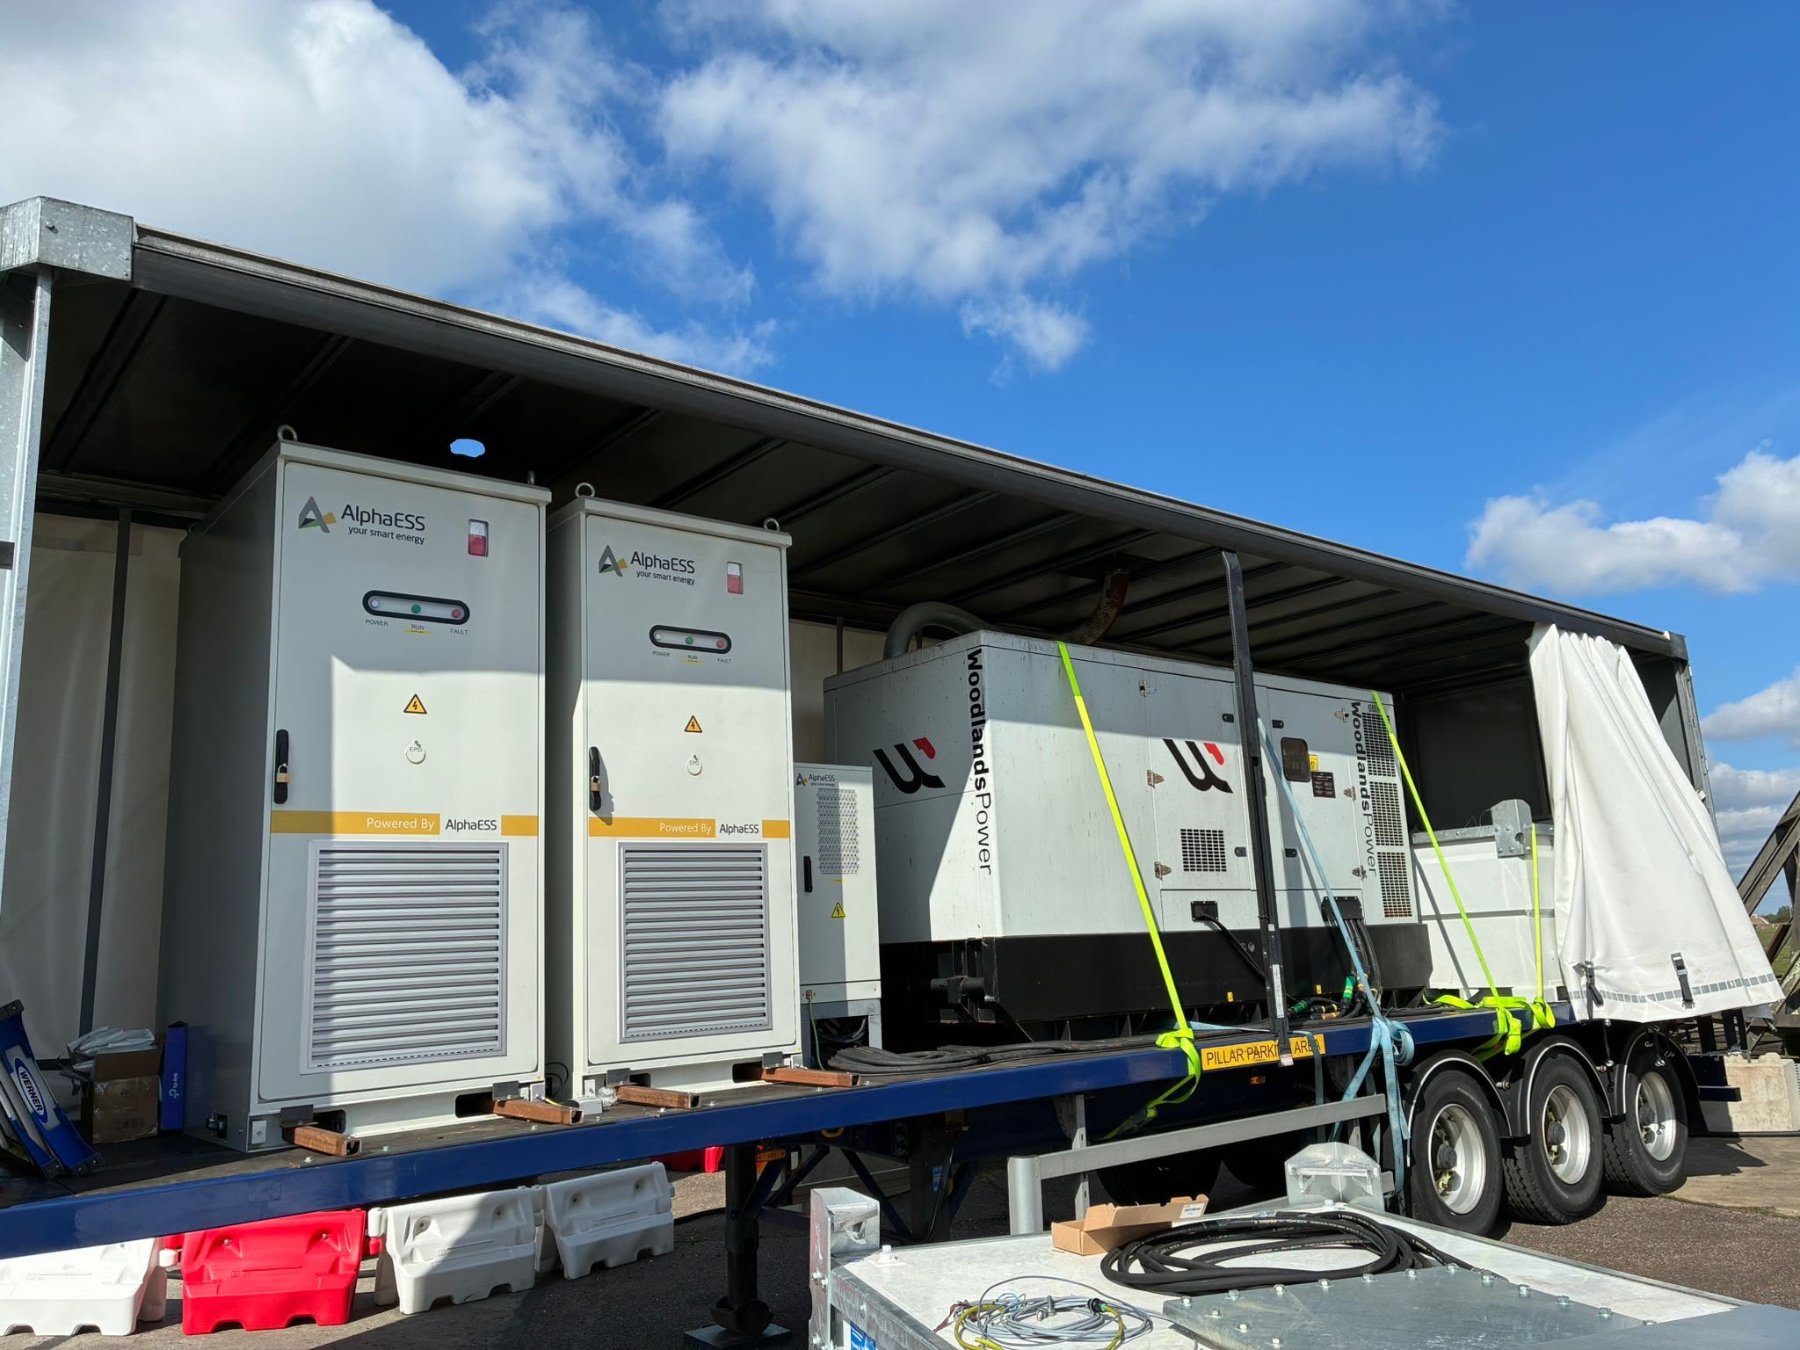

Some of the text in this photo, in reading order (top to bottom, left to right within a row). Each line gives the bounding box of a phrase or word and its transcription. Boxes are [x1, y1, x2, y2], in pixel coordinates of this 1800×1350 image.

[341, 503, 425, 531] AlphaESS
[347, 526, 425, 546] your smart energy
[630, 550, 695, 574] AlphaESS
[636, 570, 696, 587] your smart energy
[365, 619, 388, 627] POWER
[808, 773, 835, 782] AlphaESS
[366, 817, 497, 833] Powered By AlphaESS
[659, 822, 759, 836] Powered By AlphaESS
[1206, 1048, 1244, 1066] PILLAR
[1246, 1043, 1280, 1061] PARKI
[20, 1070, 43, 1112] WERNER
